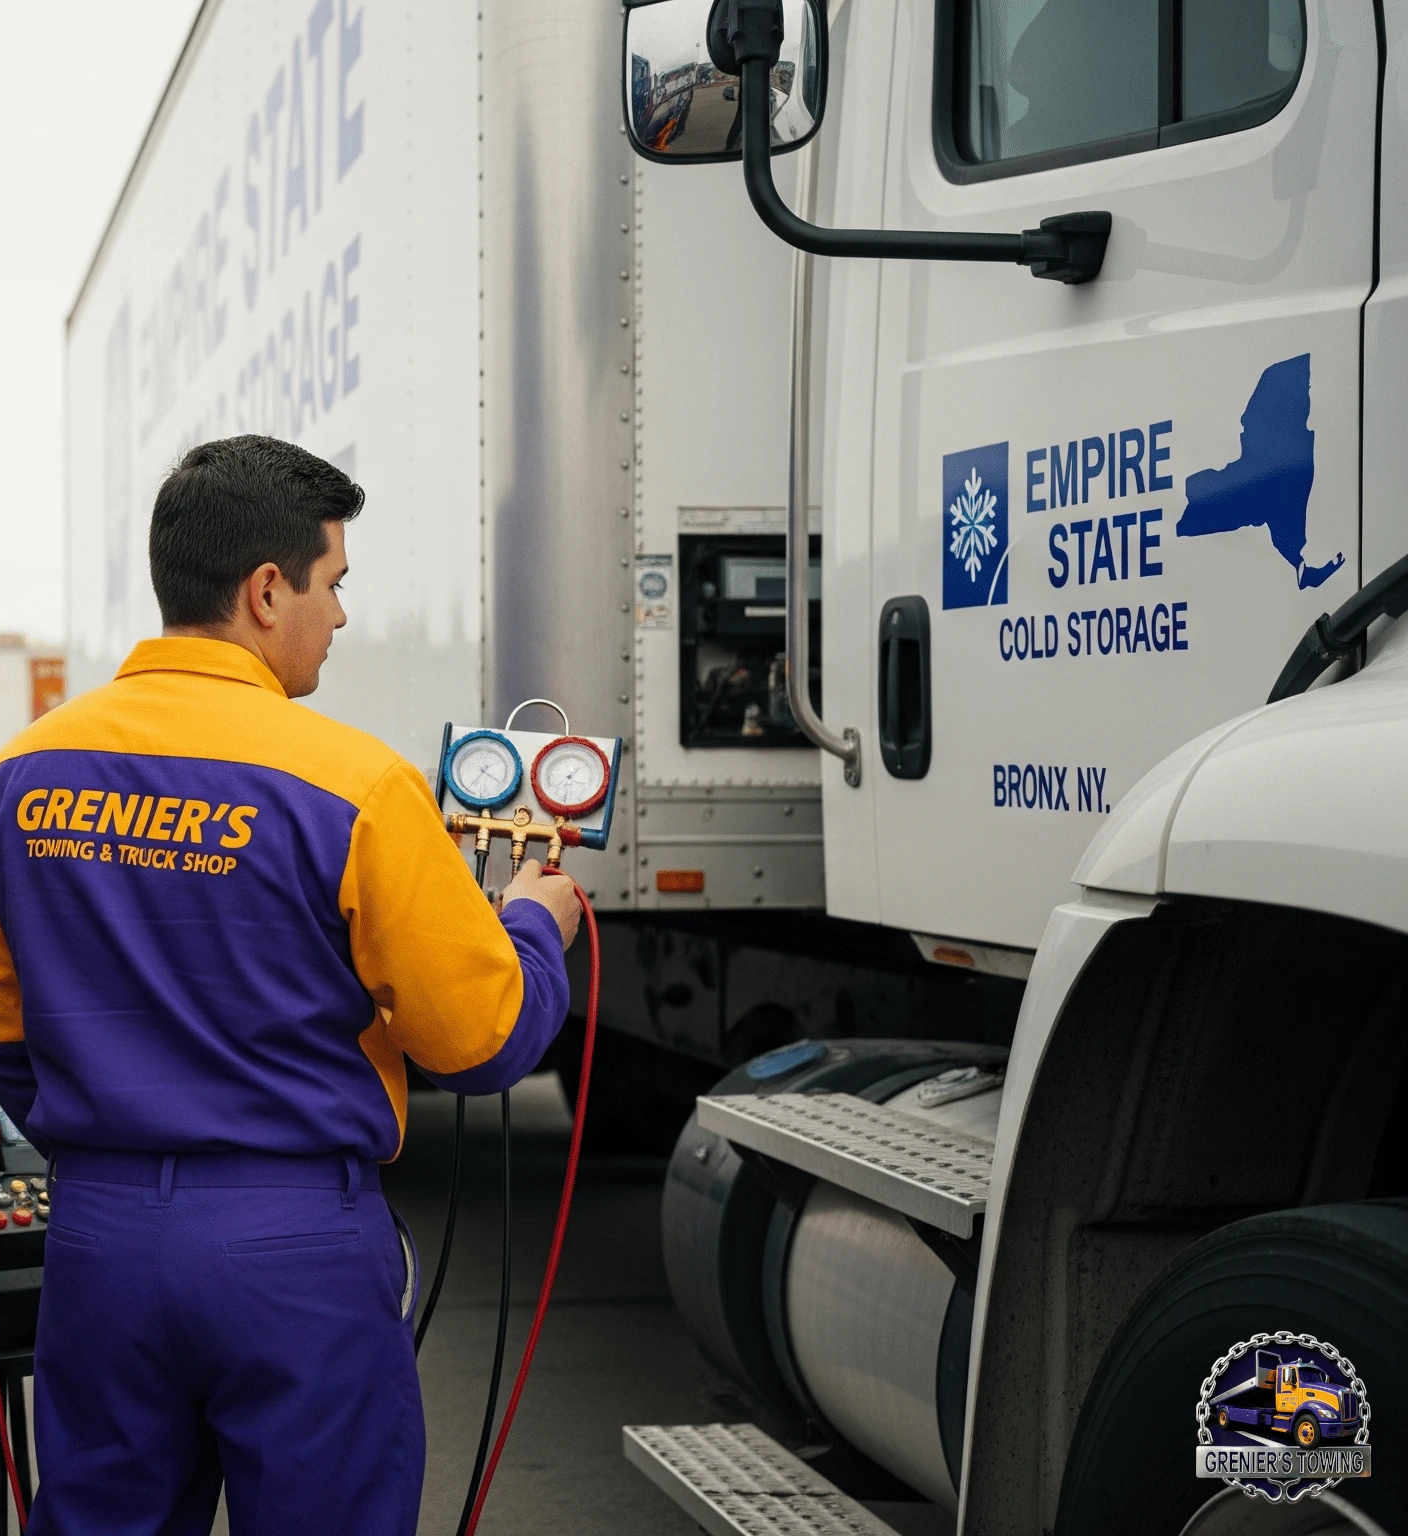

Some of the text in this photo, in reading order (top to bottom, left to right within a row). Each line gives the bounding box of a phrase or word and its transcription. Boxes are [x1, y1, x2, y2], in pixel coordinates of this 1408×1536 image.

[242, 0, 364, 312] STATE
[235, 232, 362, 440] STORAGE
[1026, 419, 1173, 513] EMPIRE
[1047, 508, 1163, 589] STATE
[999, 601, 1189, 662] COLD STORAGE
[16, 788, 259, 849] GRENIER'S
[26, 838, 238, 876] TOWING & TRUCK SHOP
